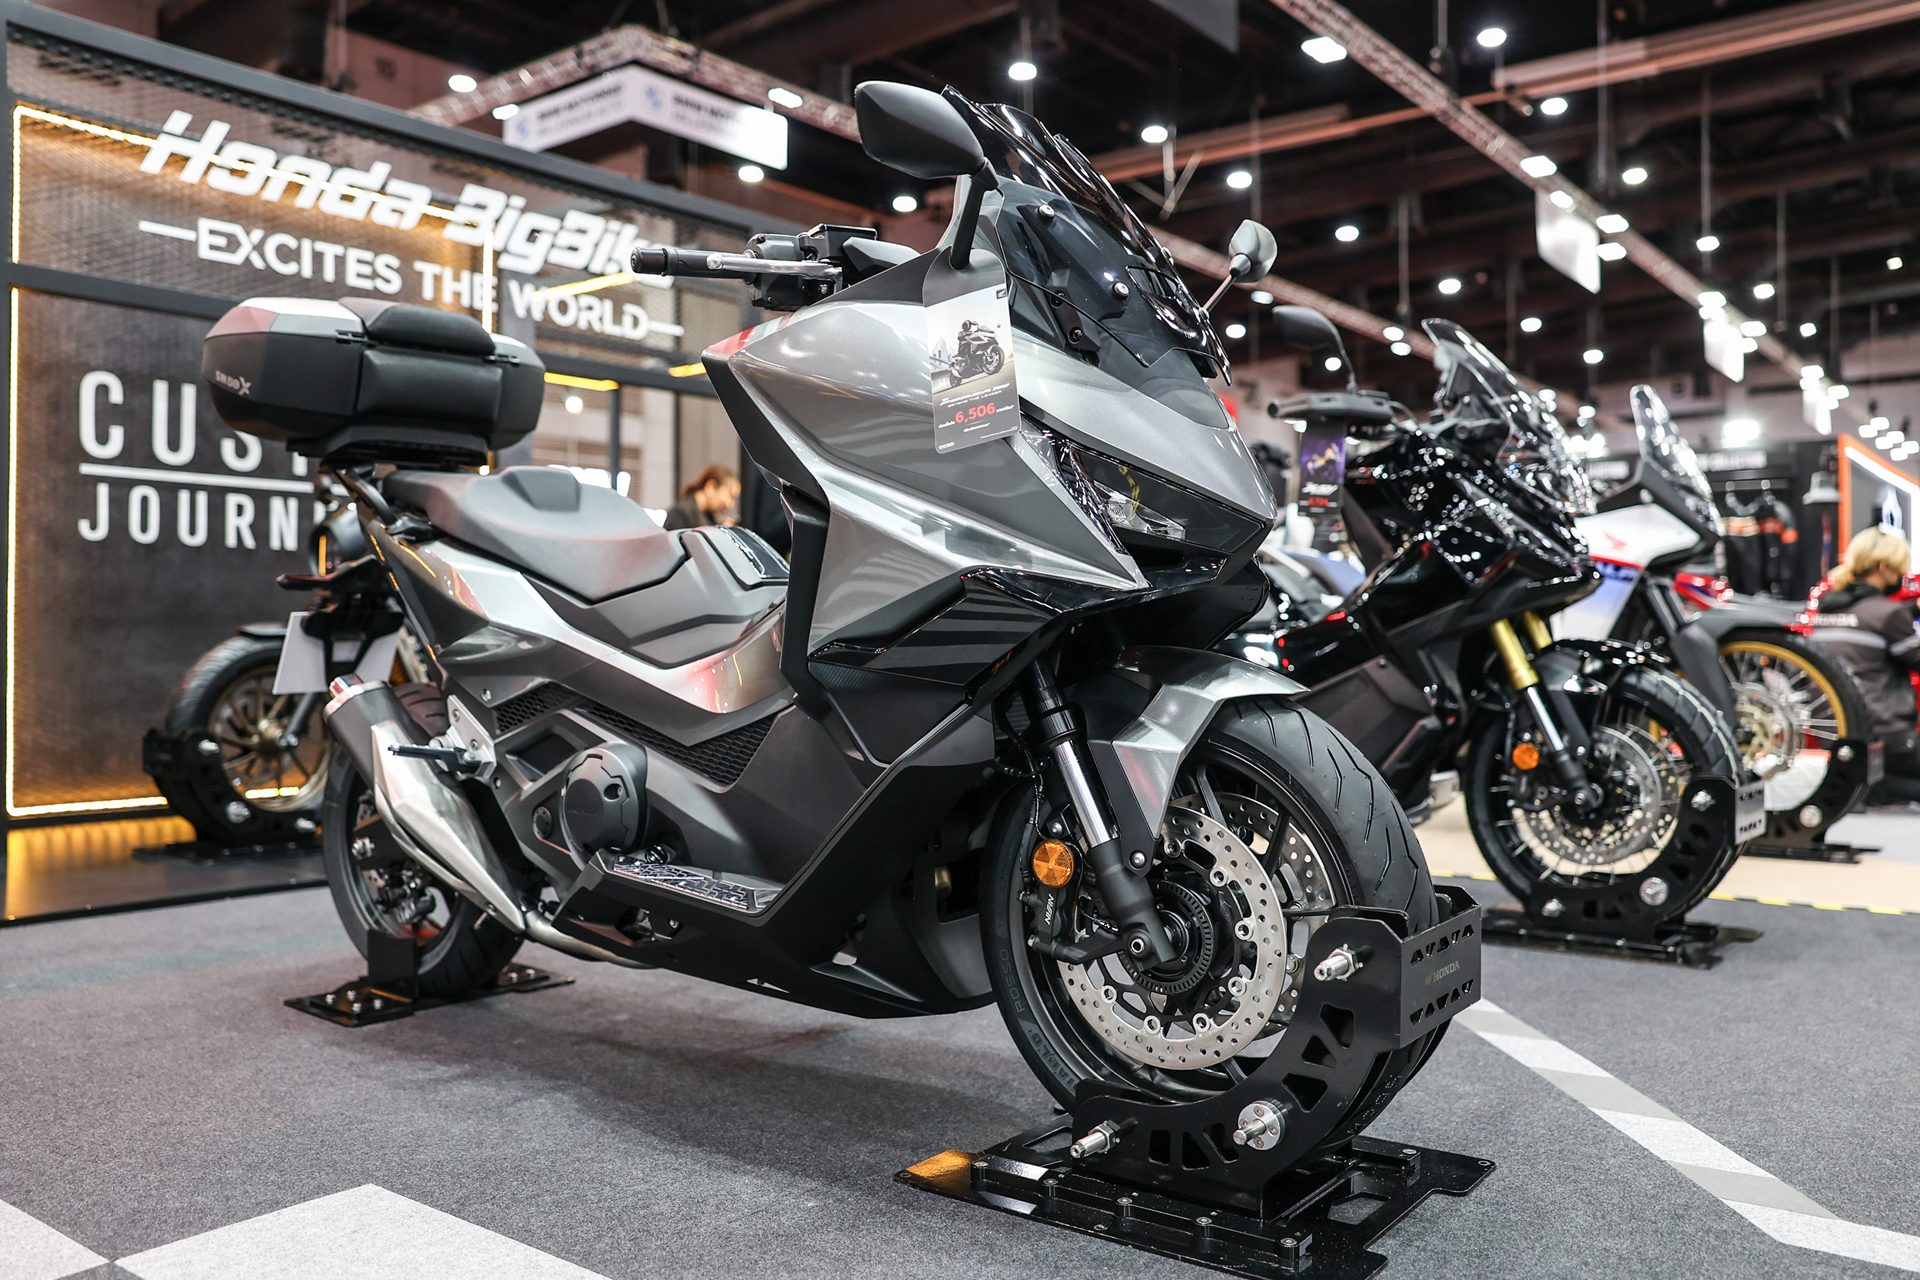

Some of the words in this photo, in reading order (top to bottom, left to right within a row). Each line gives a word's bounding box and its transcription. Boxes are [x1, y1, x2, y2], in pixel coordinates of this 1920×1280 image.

[140, 109, 432, 232] Honda
[444, 182, 675, 290] BigBik
[197, 216, 403, 295] EXCITES
[413, 260, 499, 314] THE
[508, 279, 650, 341] WORLD
[79, 369, 308, 477] CUS
[954, 402, 996, 425] 6,506
[1000, 948, 1026, 1014] ROSSO
[1432, 960, 1461, 984] HONDA
